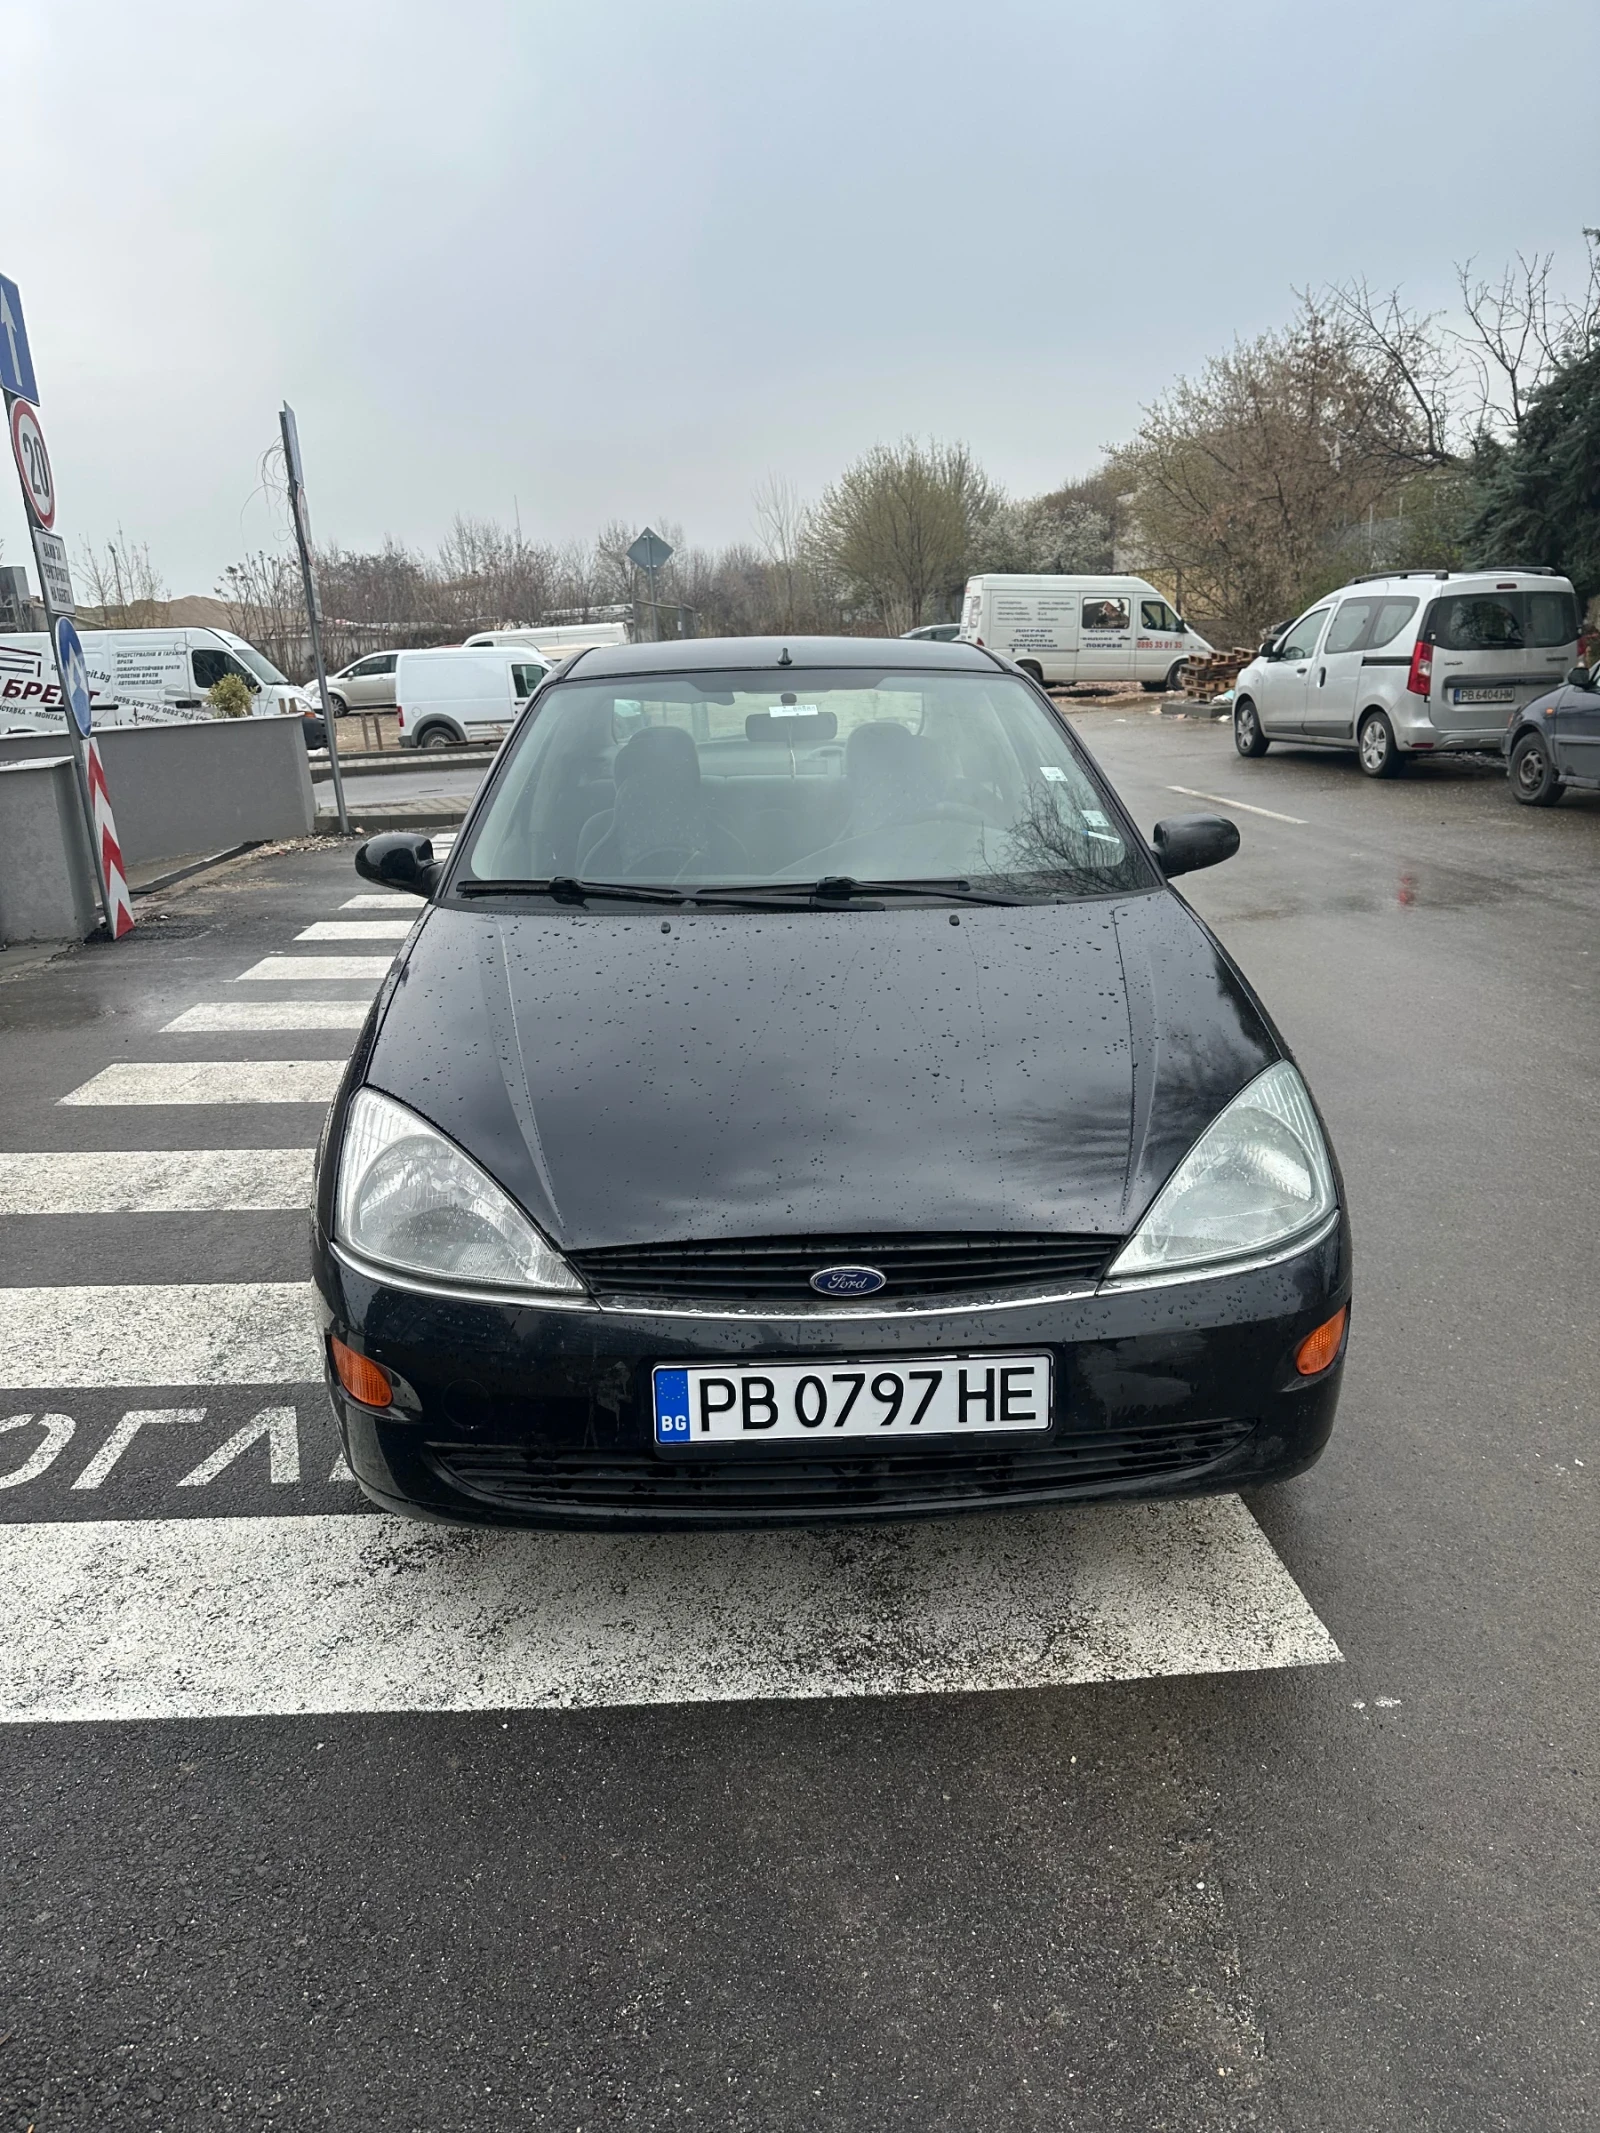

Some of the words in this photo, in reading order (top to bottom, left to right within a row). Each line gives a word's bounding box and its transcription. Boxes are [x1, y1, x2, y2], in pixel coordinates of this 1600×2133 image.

[22, 432, 50, 498] 20
[1461, 690, 1474, 700] PB
[1475, 690, 1499, 700] 6404
[1500, 689, 1513, 699] HM
[34, 711, 65, 721] МОНТАЖ
[827, 1272, 869, 1291] Ford
[699, 1376, 779, 1432] PB
[794, 1371, 943, 1428] 0797
[958, 1366, 1037, 1423] HE
[661, 1415, 687, 1432] BG
